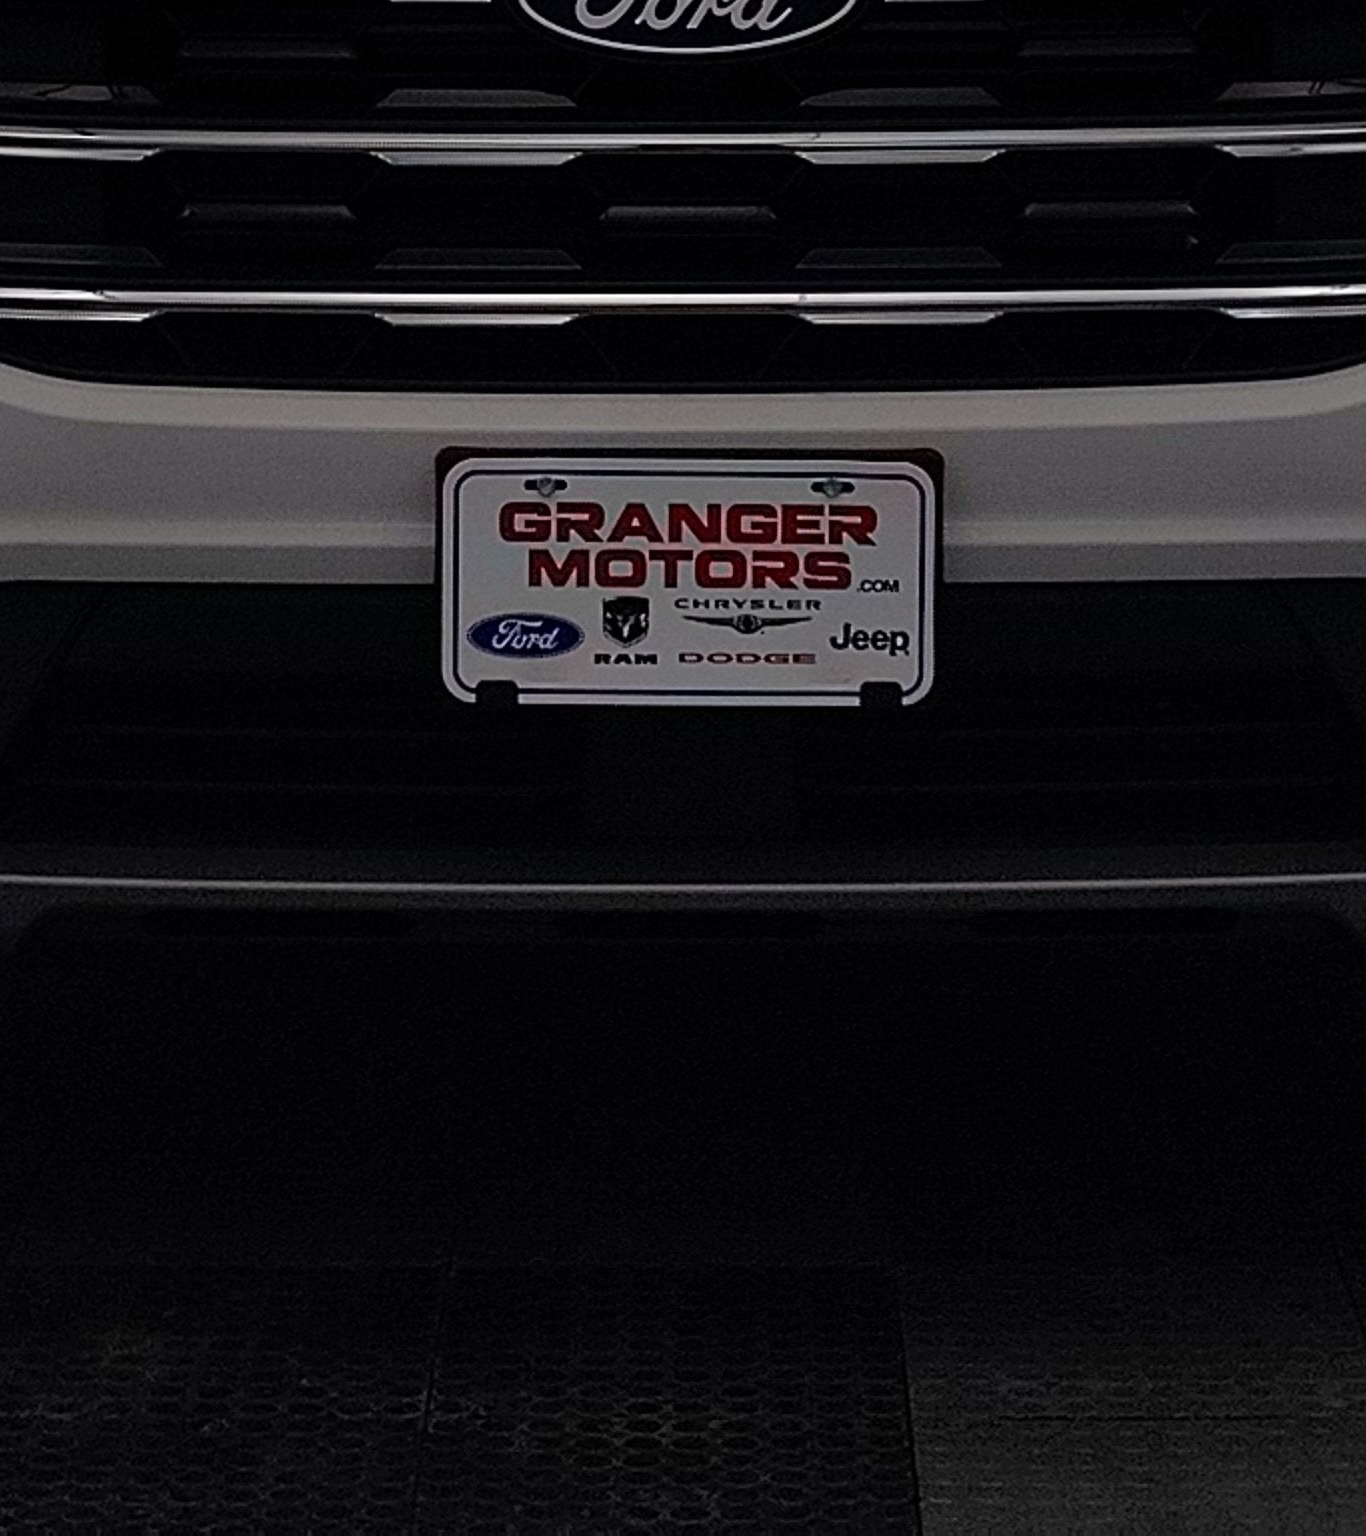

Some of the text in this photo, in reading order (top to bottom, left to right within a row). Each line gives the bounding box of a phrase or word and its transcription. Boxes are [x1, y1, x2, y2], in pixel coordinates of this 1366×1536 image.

[498, 501, 878, 546] GRANGER
[527, 549, 852, 591] MOTORS
[674, 598, 822, 611] CHRYSLER
[491, 618, 561, 651] Ford
[829, 622, 910, 657] Jeep
[593, 653, 658, 666] RAM
[678, 652, 817, 665] DODGE
